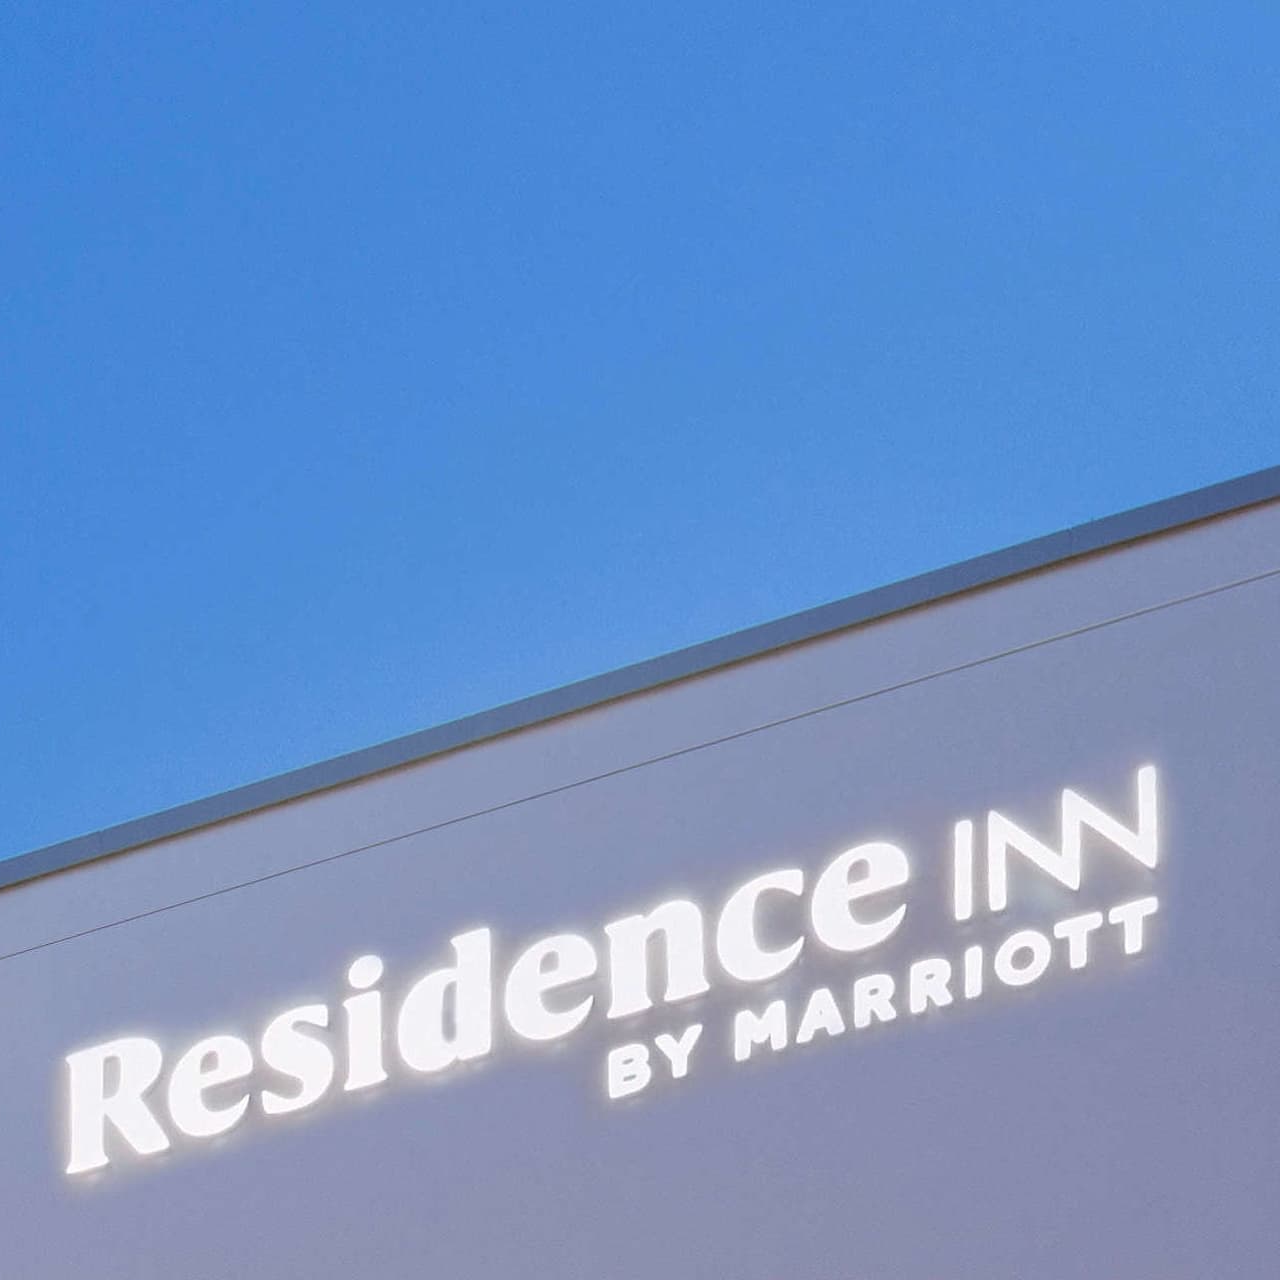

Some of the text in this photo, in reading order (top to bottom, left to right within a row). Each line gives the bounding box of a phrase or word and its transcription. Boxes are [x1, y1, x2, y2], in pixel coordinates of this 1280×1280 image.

[65, 765, 1158, 1175] Residence INN
[607, 896, 1159, 1099] BY MARRIOTT
